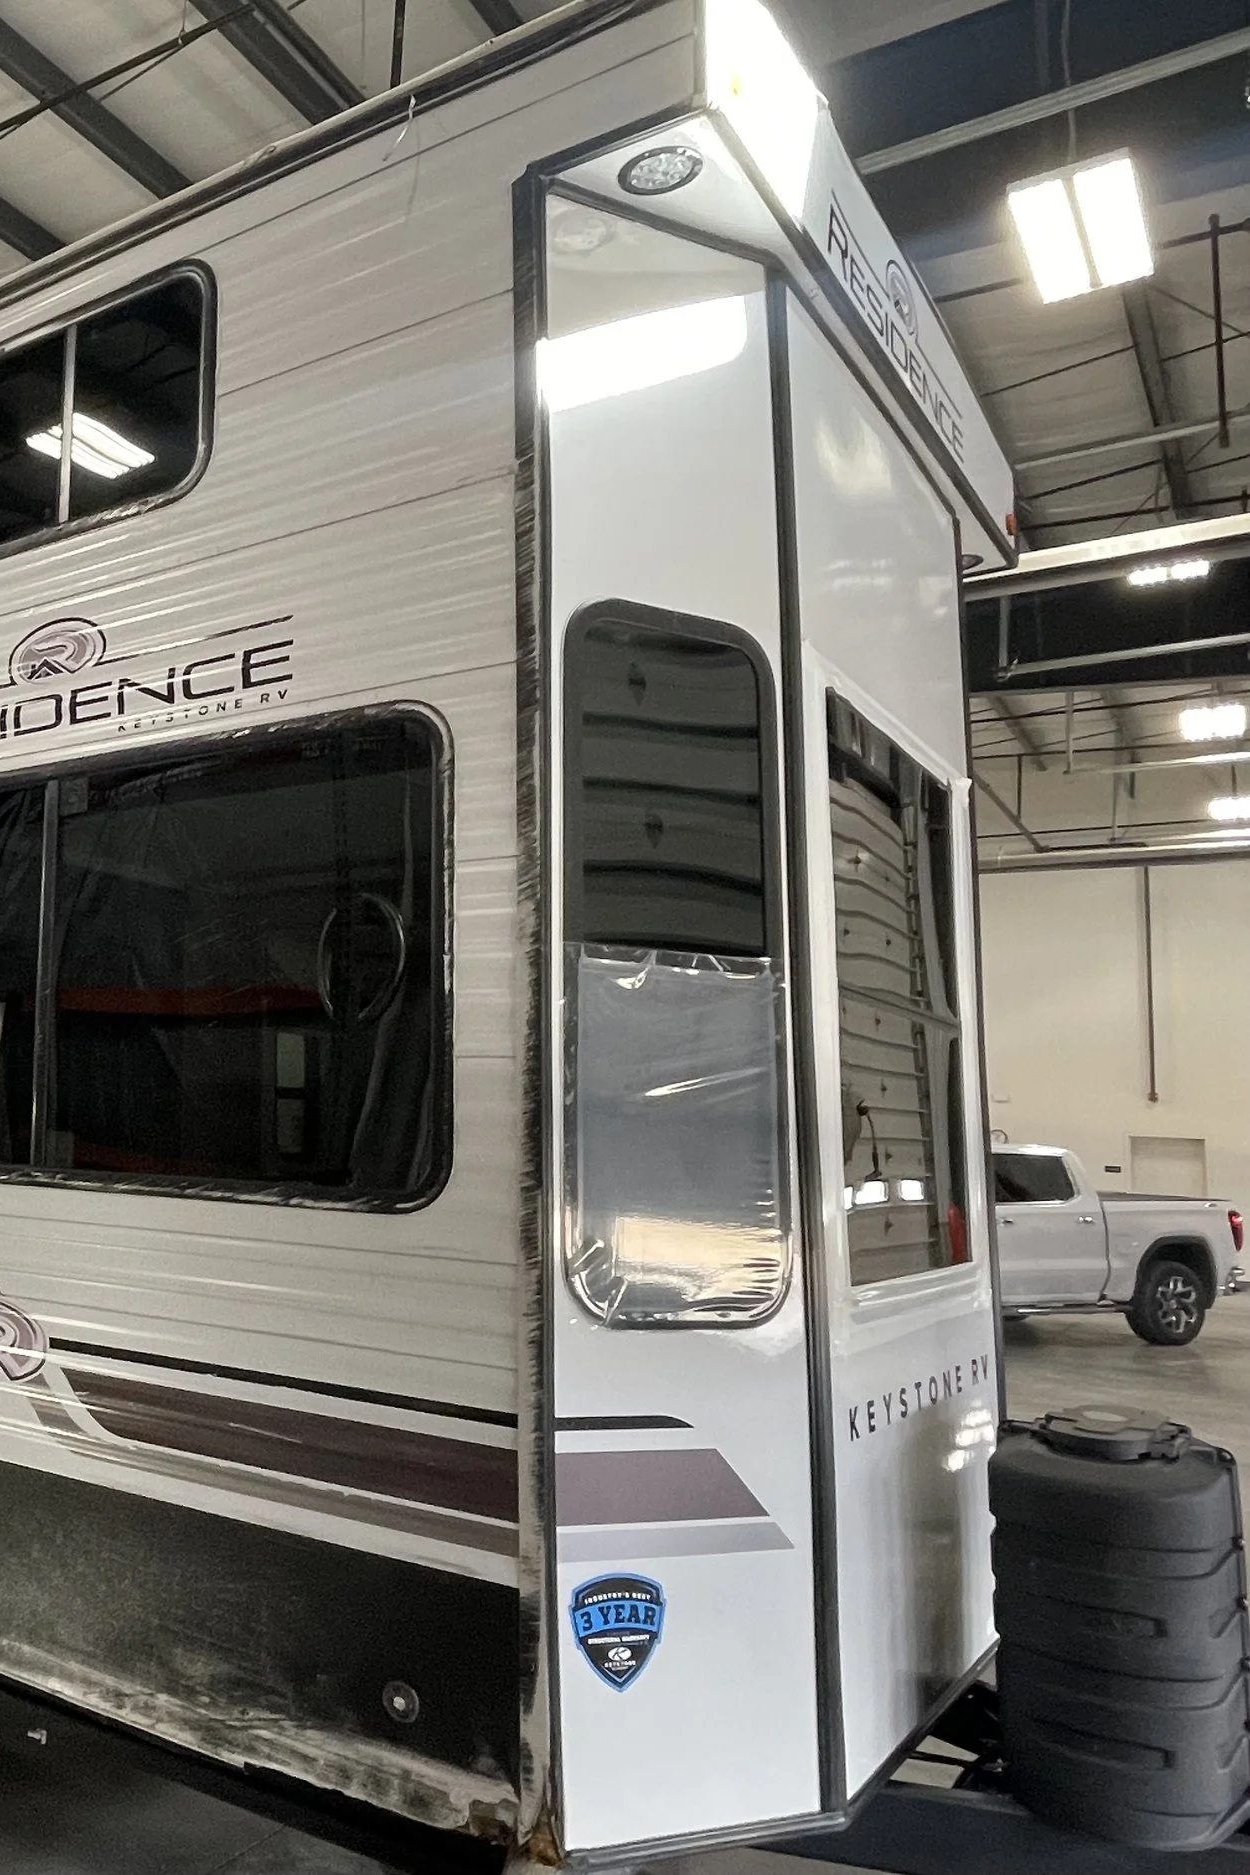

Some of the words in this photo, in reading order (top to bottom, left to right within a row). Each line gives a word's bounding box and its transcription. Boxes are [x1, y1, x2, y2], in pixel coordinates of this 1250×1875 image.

[827, 203, 965, 463] RESIDENCE
[260, 689, 288, 704] RV
[848, 1364, 962, 1441] KEYSTONE
[971, 1354, 988, 1385] RV
[580, 1611, 593, 1631] 3
[598, 1603, 656, 1626] YEAR
